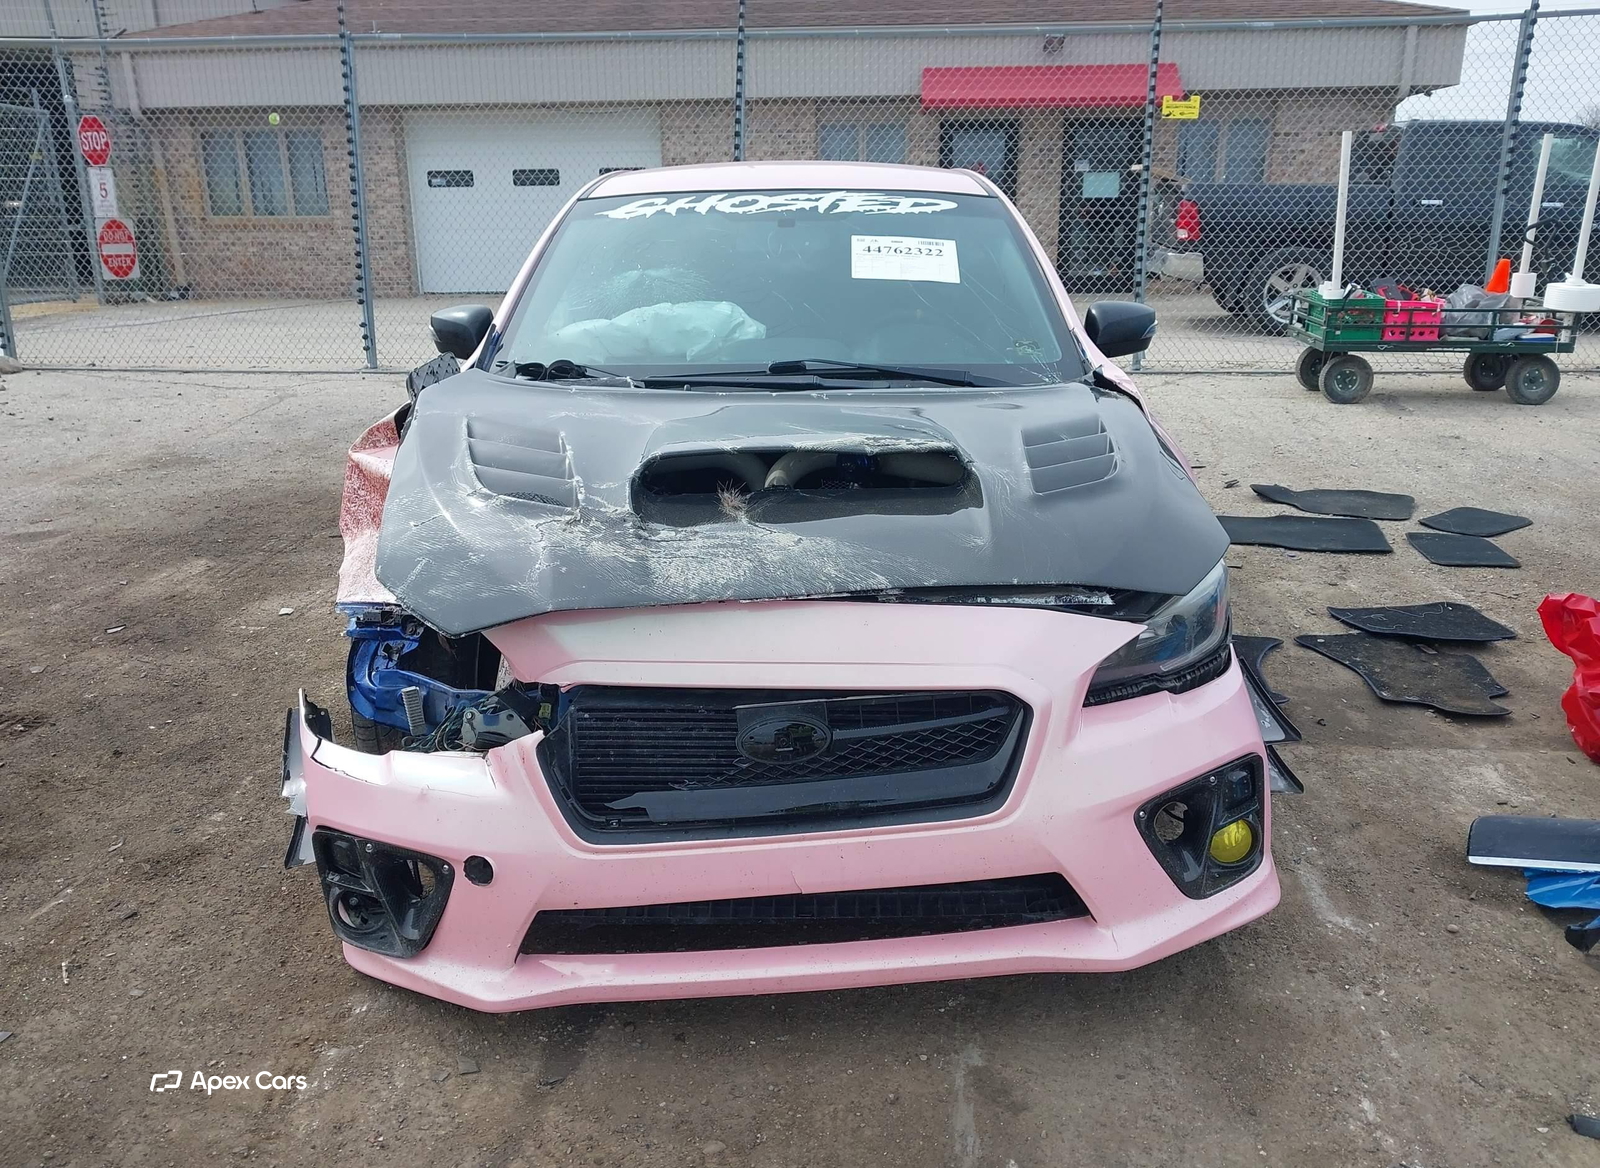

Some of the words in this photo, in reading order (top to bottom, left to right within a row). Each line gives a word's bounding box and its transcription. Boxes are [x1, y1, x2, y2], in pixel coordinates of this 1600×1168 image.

[80, 131, 107, 151] STOP
[99, 182, 108, 199] 5
[595, 191, 958, 220] GHOSTED
[103, 231, 114, 241] DO
[862, 245, 944, 257] 44762322
[108, 257, 131, 267] ENTER
